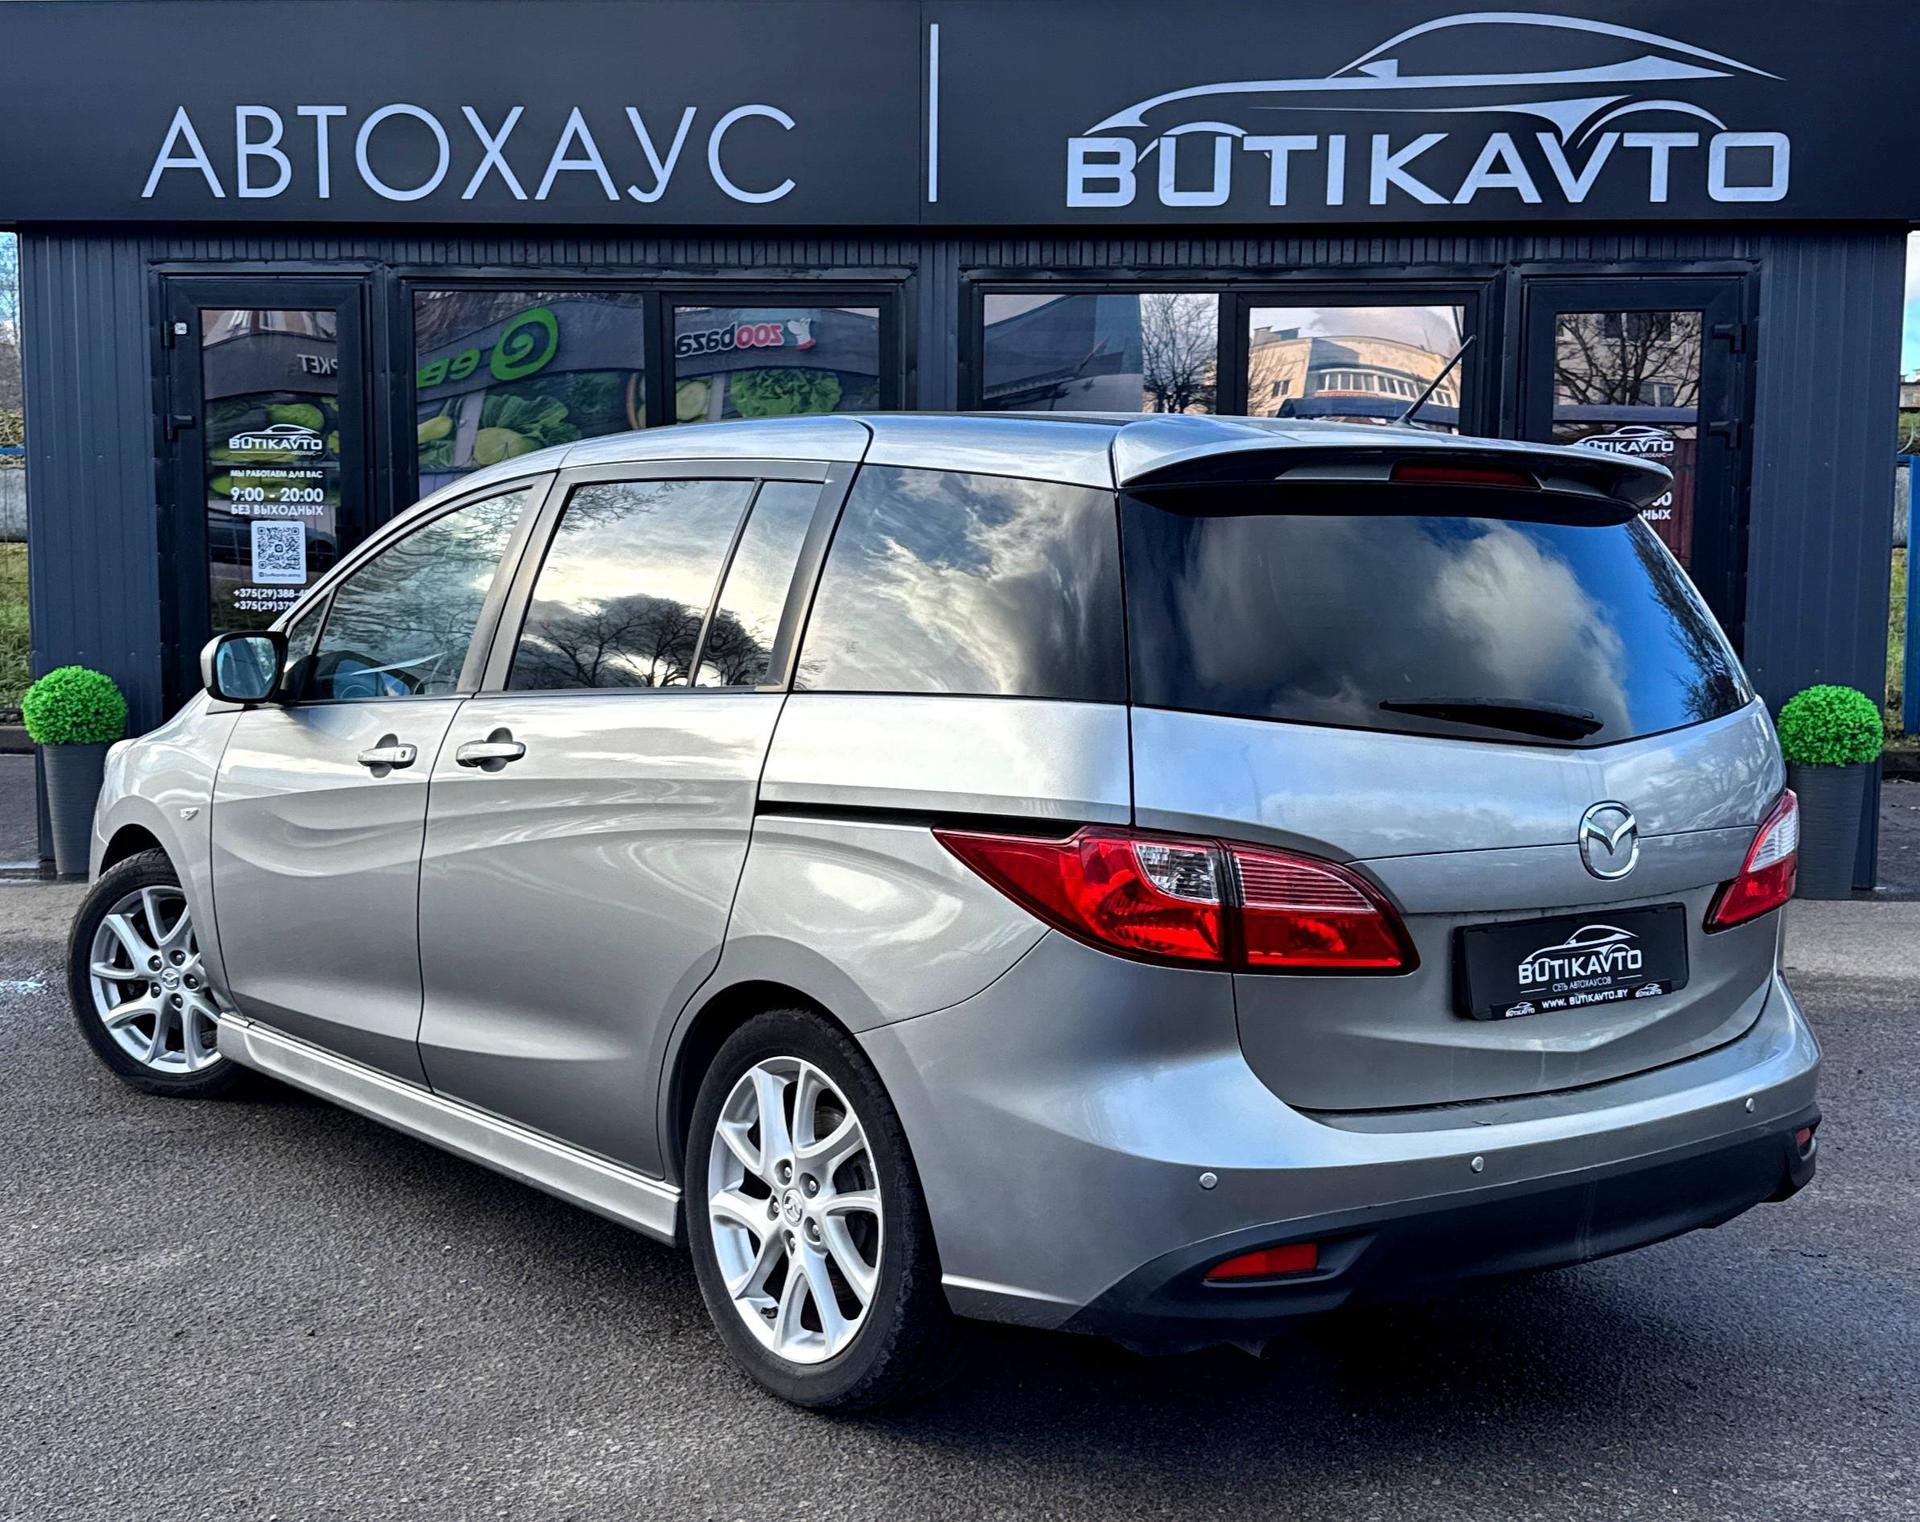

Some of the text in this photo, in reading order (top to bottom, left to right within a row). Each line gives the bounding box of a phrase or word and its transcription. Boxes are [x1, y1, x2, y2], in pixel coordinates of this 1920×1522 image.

[140, 103, 797, 204] АВТОХАУС
[1066, 131, 1790, 208] BUTIKAVTO
[229, 437, 323, 449] BUTIKAVTO
[230, 487, 264, 501] 9:00
[280, 488, 324, 502] 20:00
[231, 505, 324, 516] БЕЗ ВЫХОДНЫХ
[1518, 950, 1642, 985] BUTIKAVTO
[1552, 976, 1612, 992] СЕТЬ АВТОХАУСОВ
